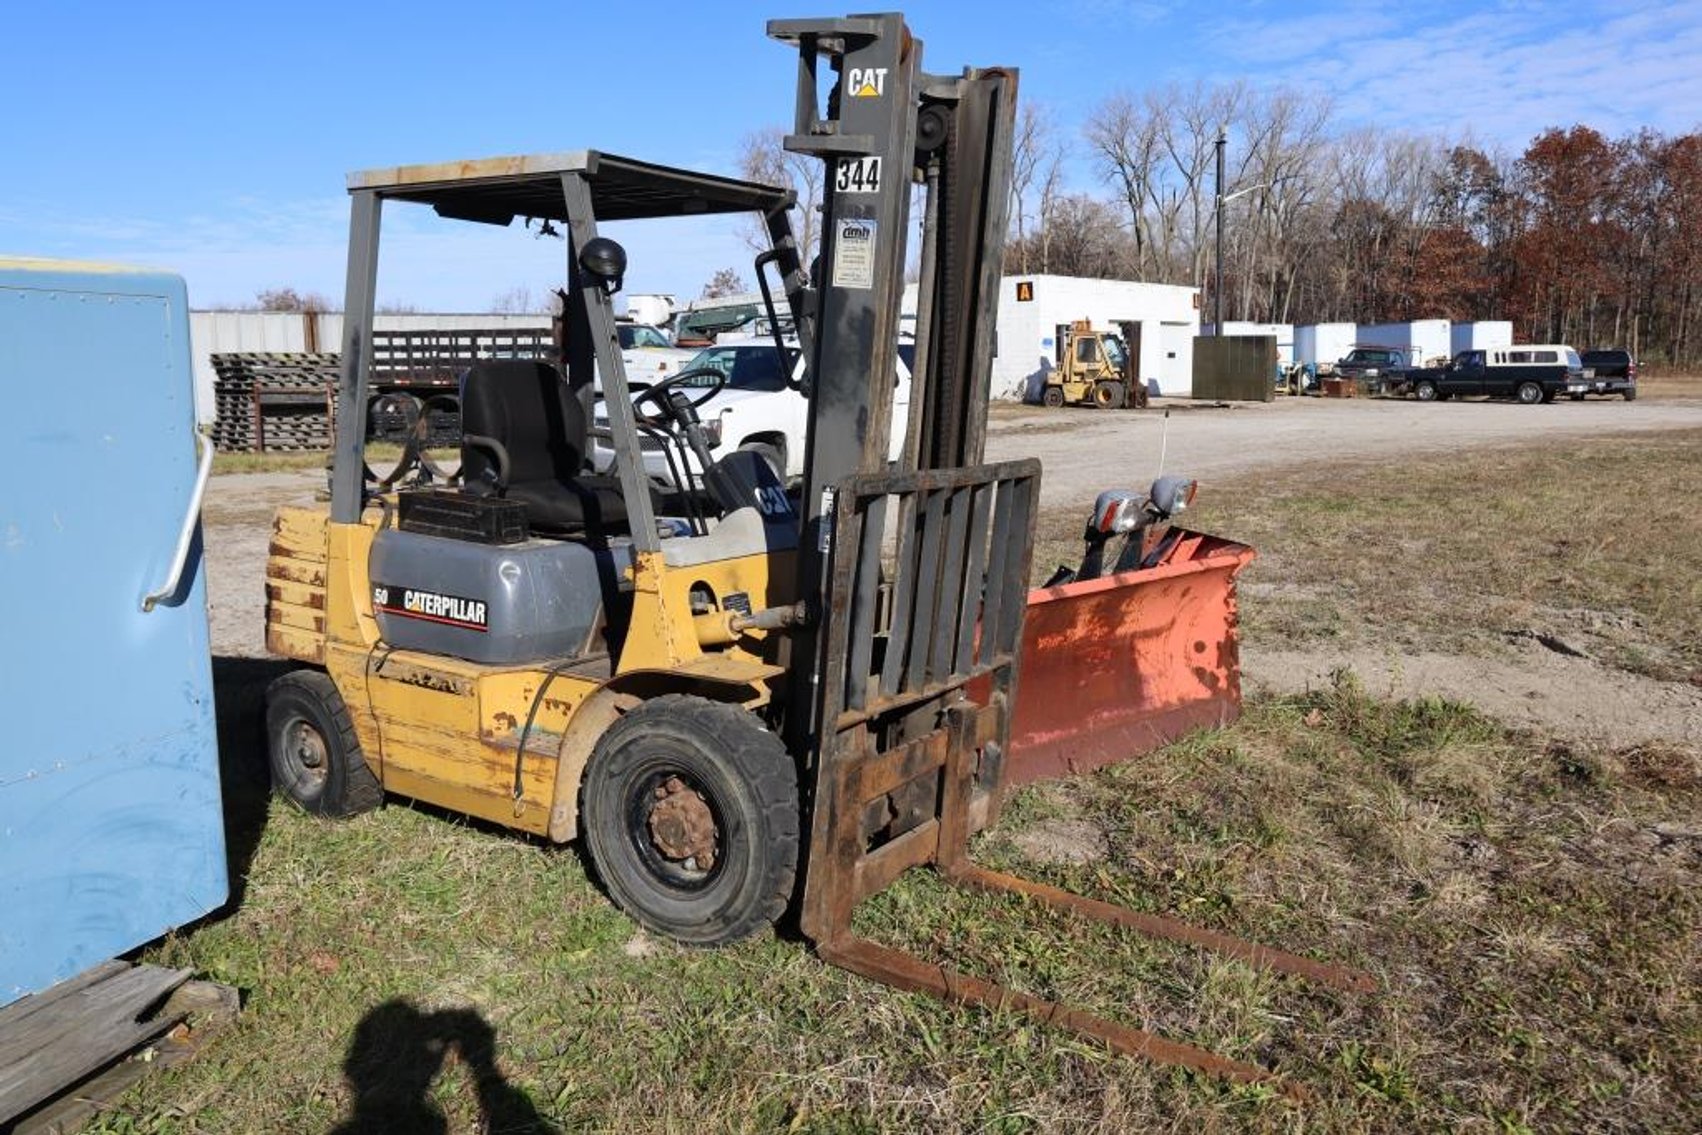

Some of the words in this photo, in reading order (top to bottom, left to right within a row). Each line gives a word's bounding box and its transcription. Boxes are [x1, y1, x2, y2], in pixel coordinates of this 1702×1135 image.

[848, 68, 888, 97] CAT
[837, 159, 879, 192] 344
[1020, 284, 1030, 300] A
[755, 485, 794, 516] CAT
[404, 590, 486, 624] CATERPILLAR
